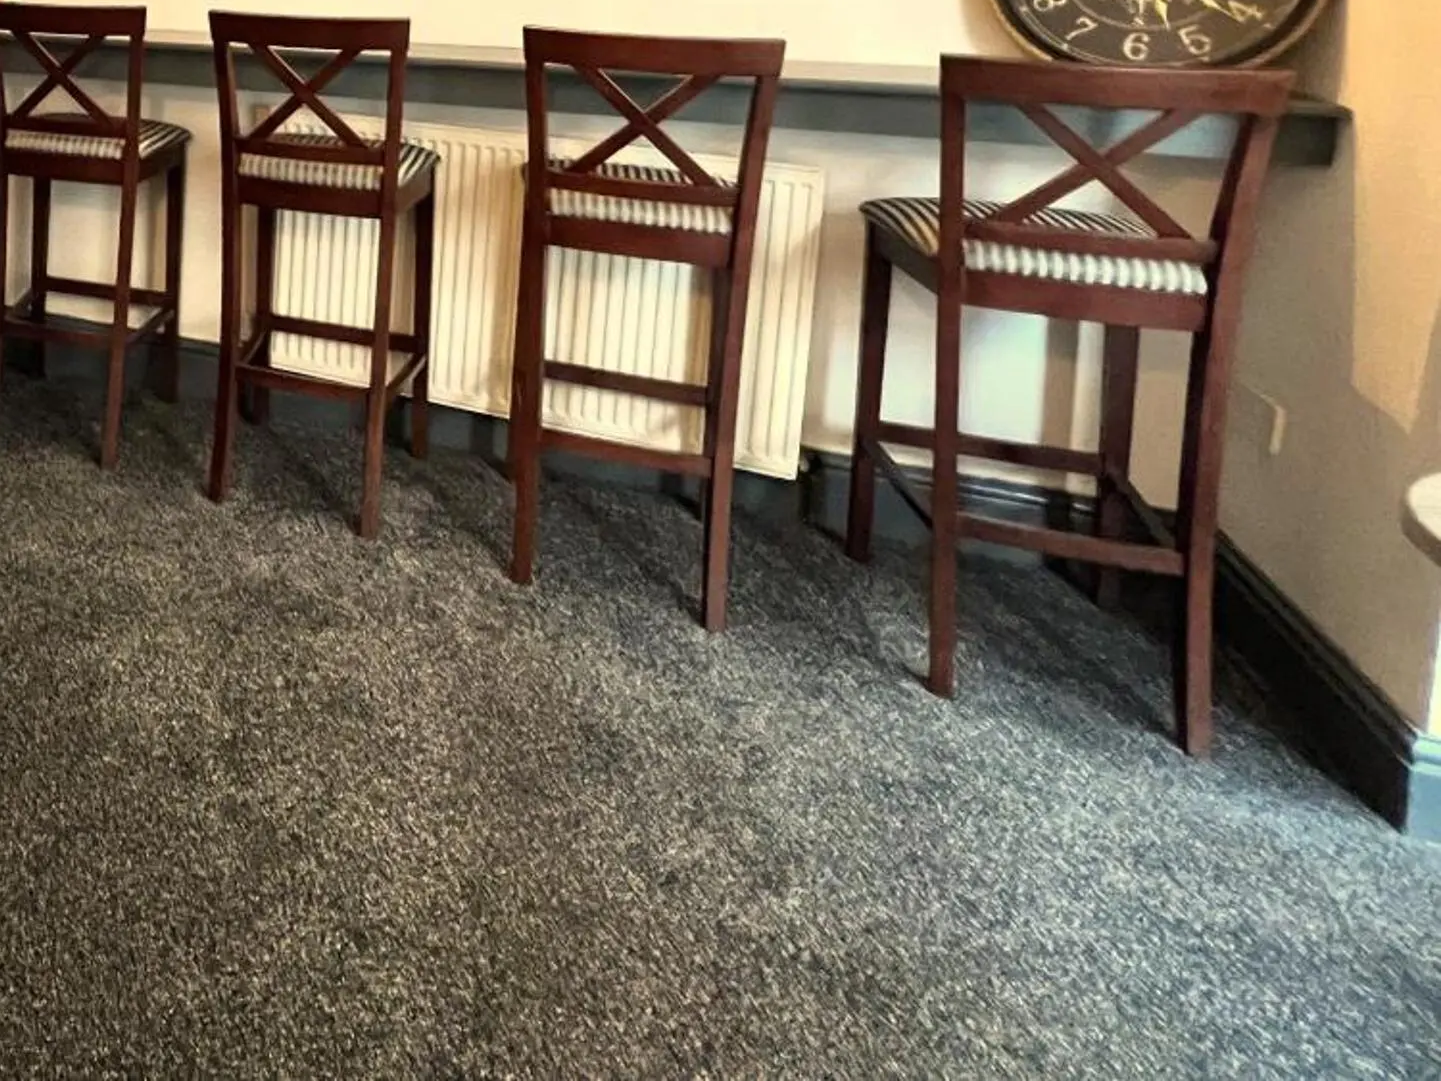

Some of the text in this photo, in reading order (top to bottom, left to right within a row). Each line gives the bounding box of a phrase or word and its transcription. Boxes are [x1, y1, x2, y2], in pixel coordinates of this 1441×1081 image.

[1064, 17, 1099, 41] 7
[1176, 24, 1212, 56] 5
[1122, 32, 1151, 61] 6
